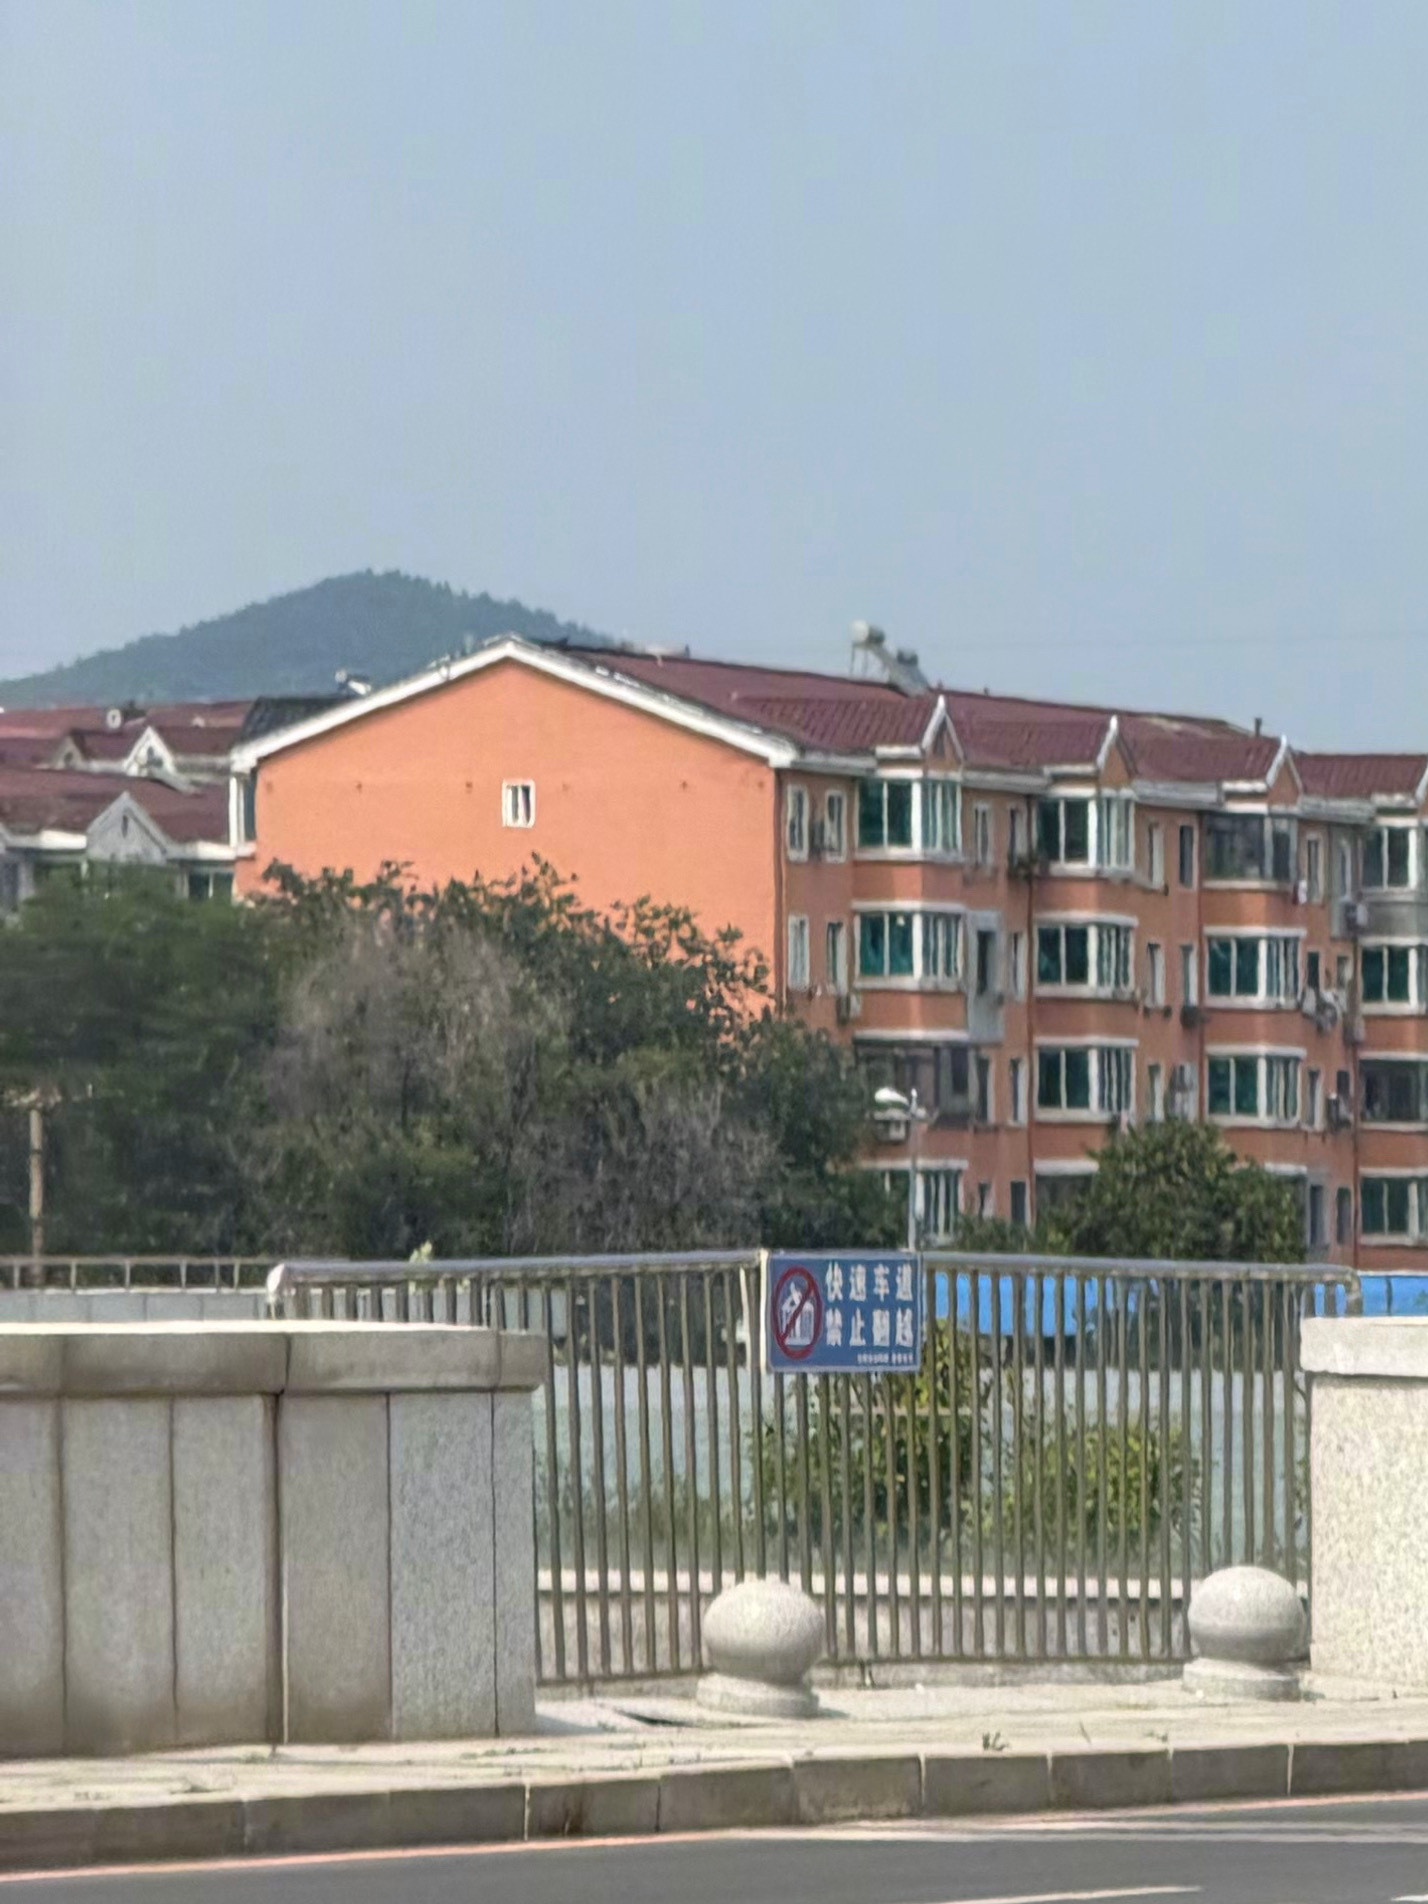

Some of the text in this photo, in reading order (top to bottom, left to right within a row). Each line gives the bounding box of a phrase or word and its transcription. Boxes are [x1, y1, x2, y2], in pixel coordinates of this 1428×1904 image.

[824, 1261, 913, 1303] 快速车道
[825, 1307, 914, 1348] 禁止翻越
